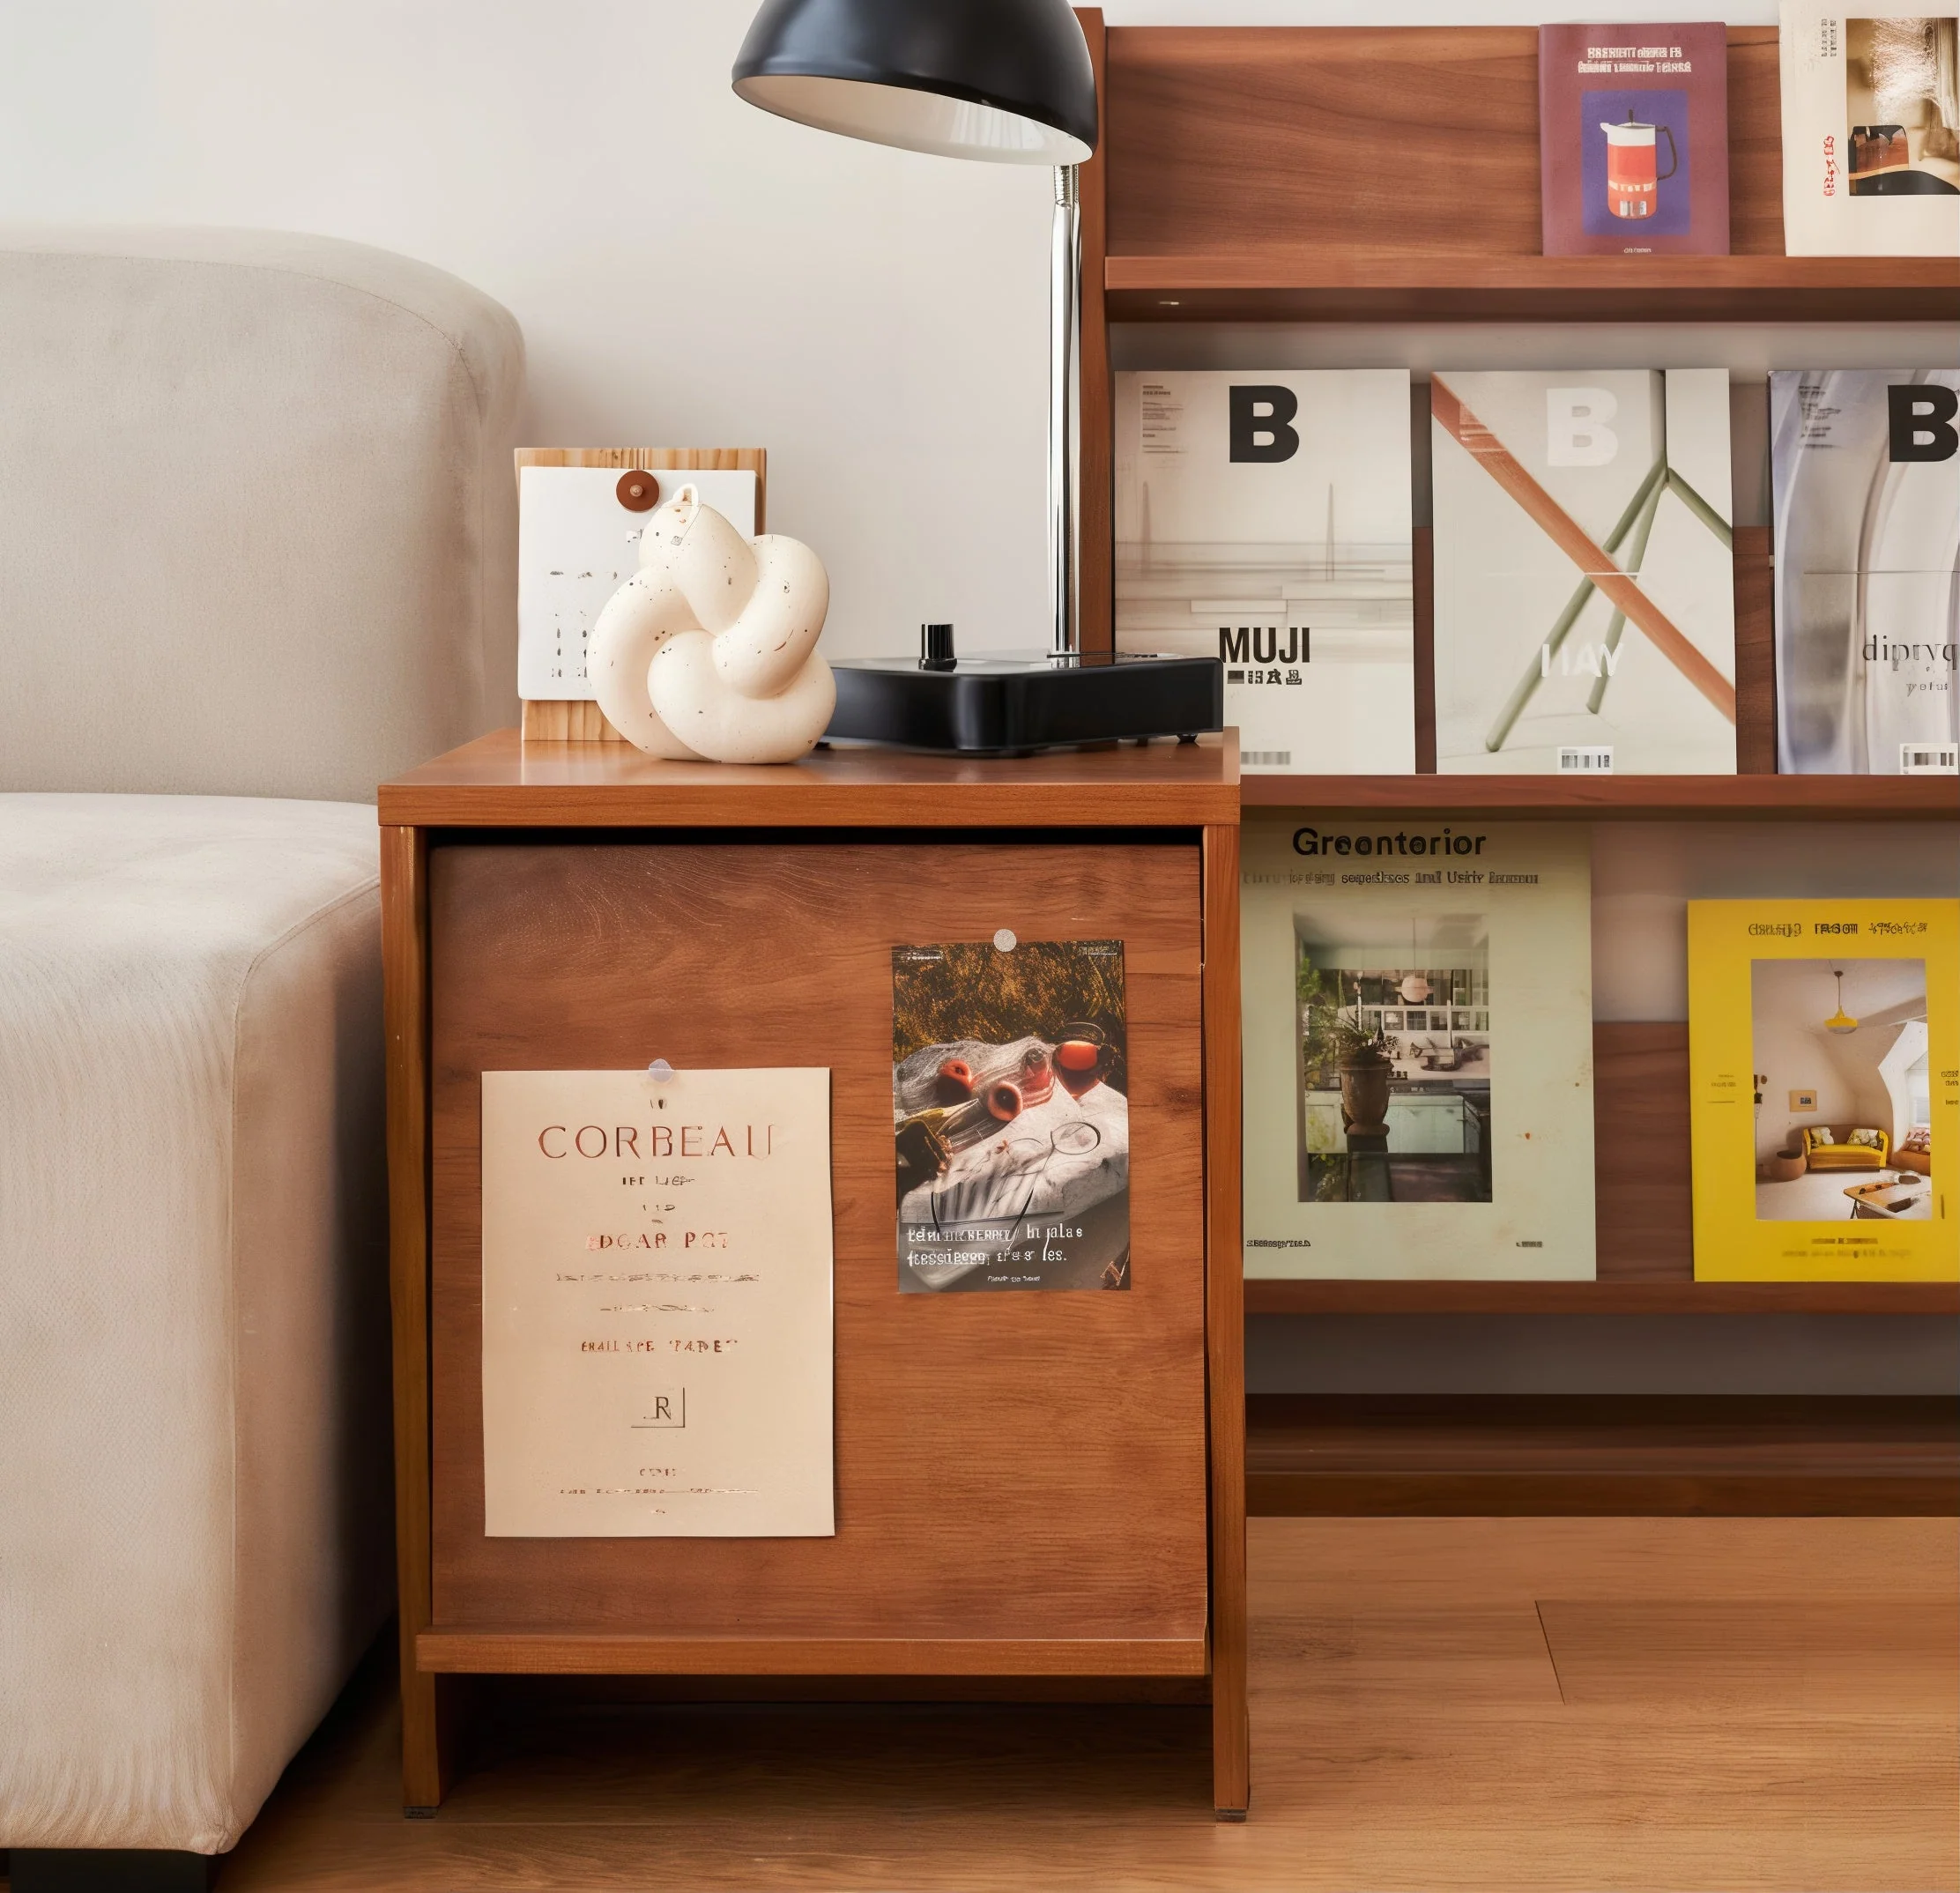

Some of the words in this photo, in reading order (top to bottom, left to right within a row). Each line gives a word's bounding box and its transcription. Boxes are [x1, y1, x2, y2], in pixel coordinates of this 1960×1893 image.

[1229, 385, 1300, 464] B
[1546, 387, 1619, 467] B
[1888, 384, 1959, 463] B
[1219, 627, 1310, 664] MUJI
[538, 1125, 775, 1161] CORBEAU
